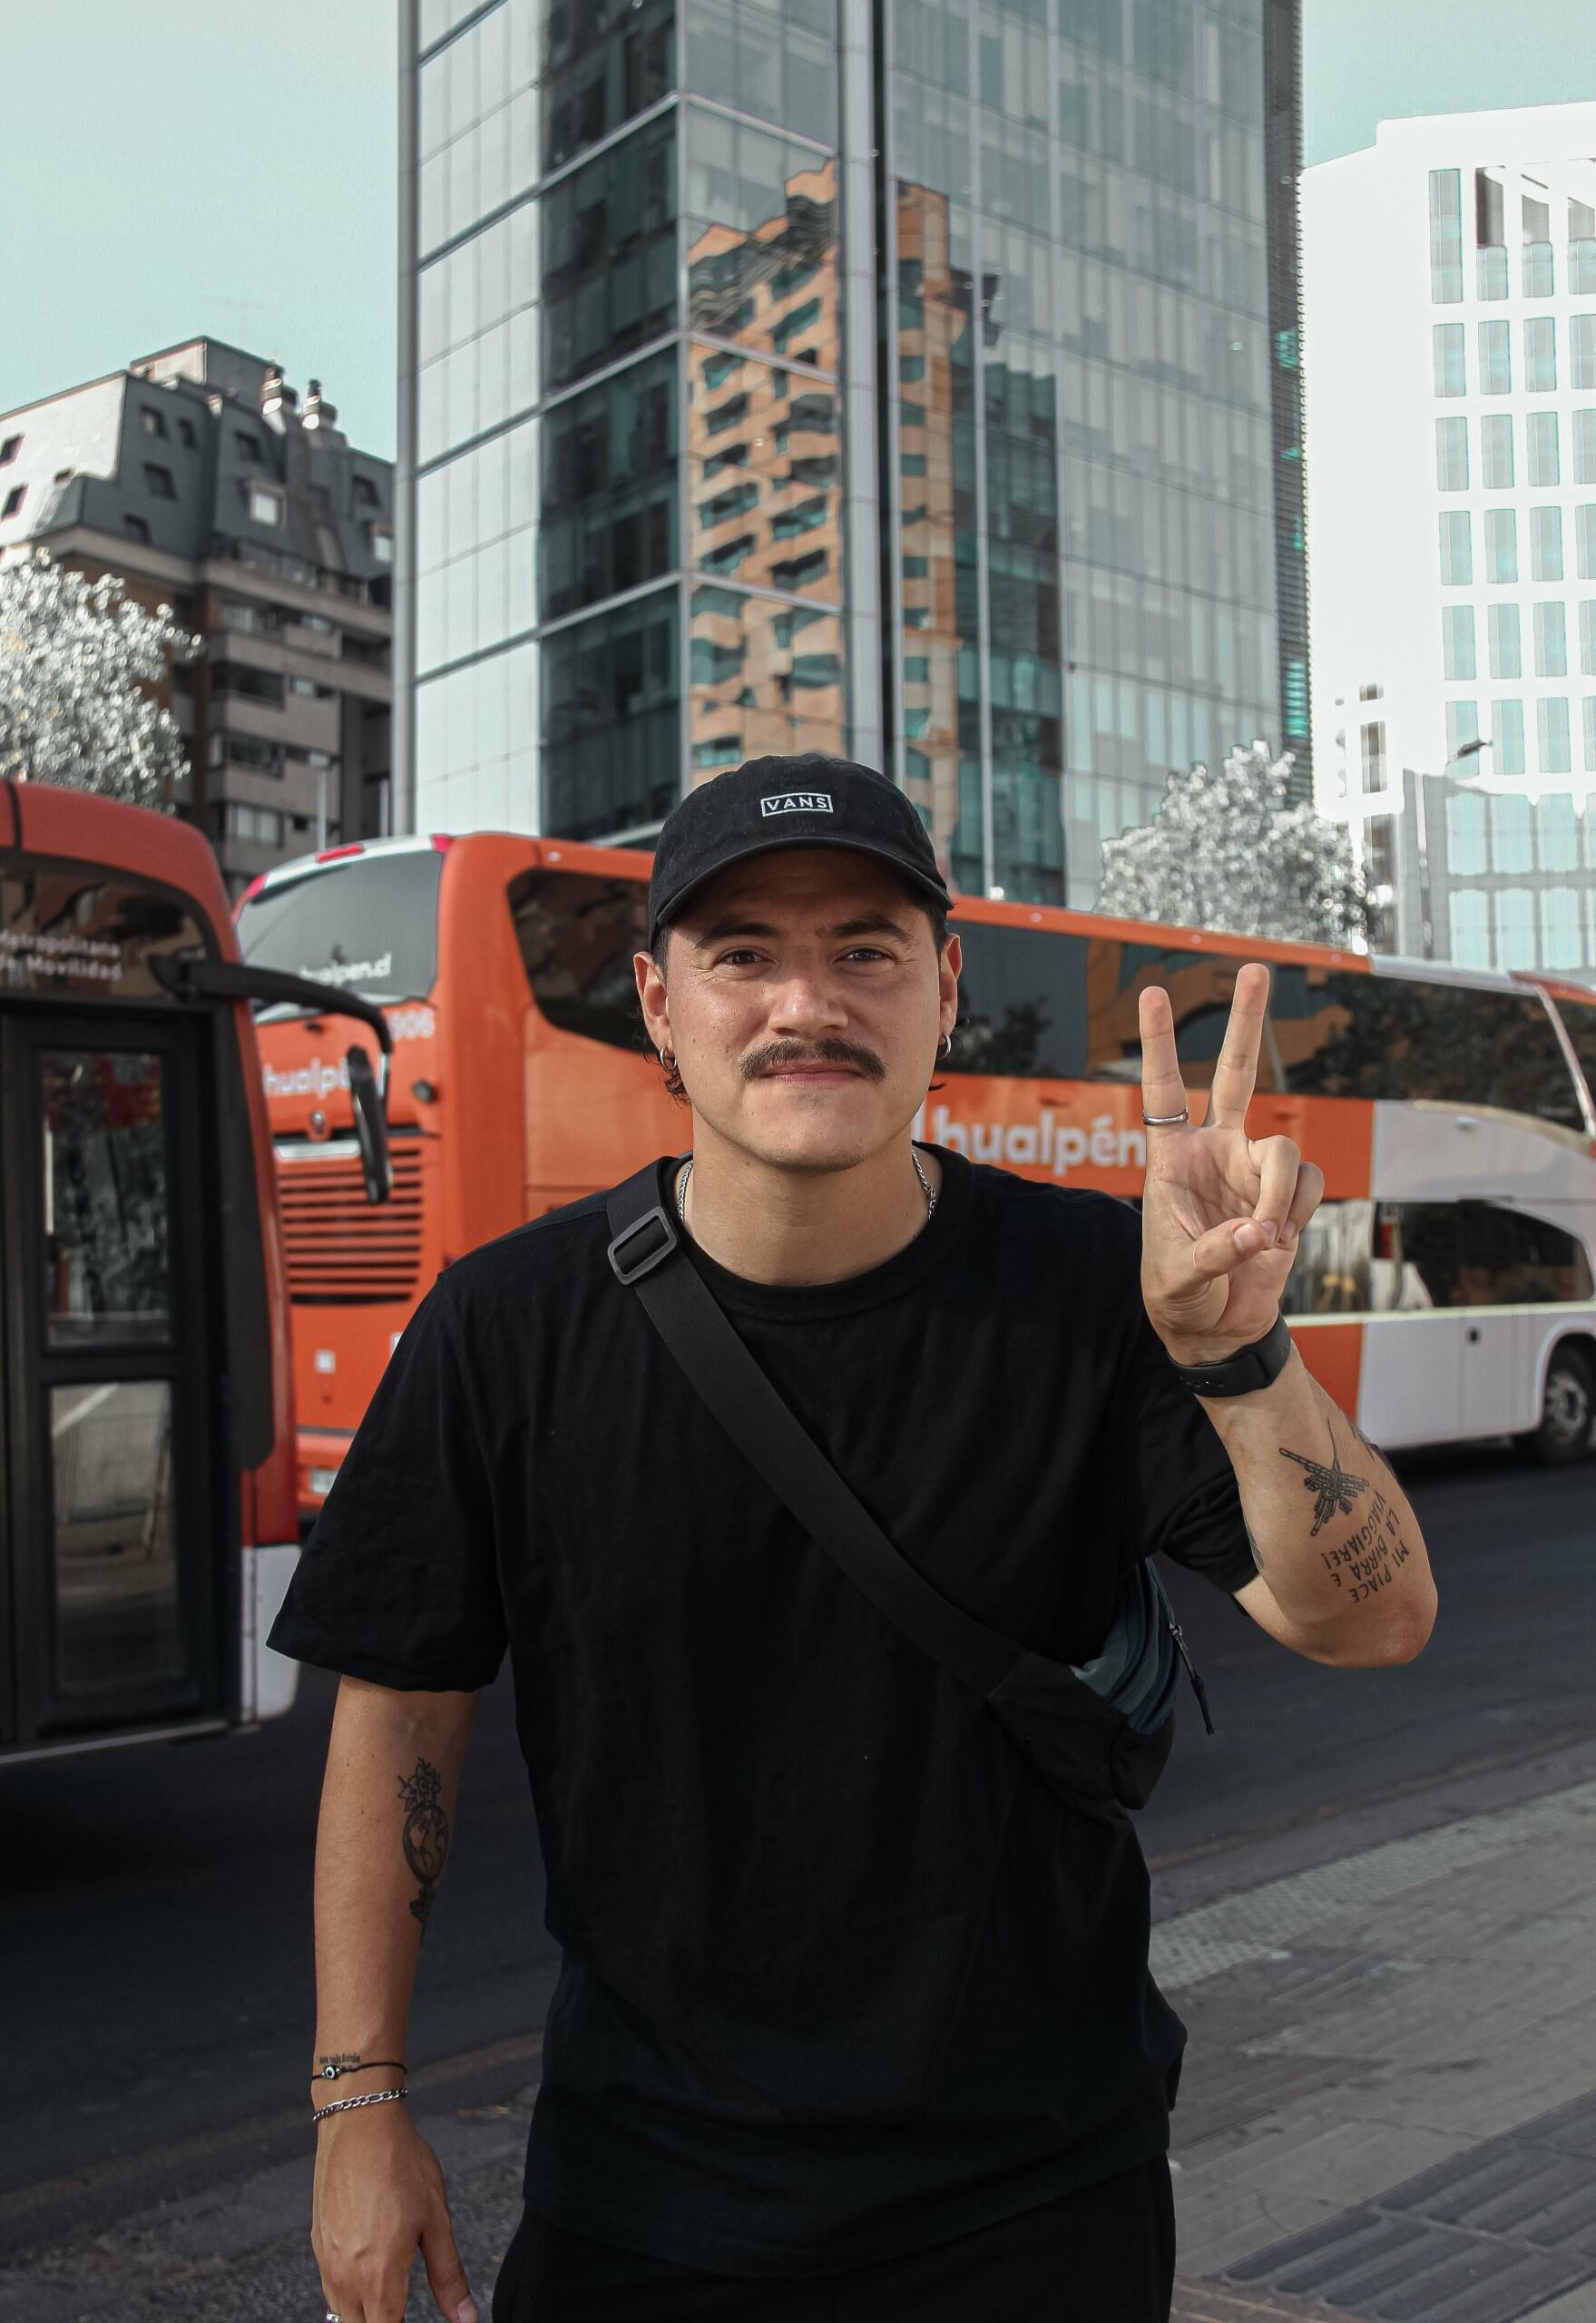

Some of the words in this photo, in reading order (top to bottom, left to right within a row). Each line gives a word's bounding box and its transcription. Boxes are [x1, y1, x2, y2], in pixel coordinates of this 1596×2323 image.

[766, 797, 827, 811] VANS
[934, 1103, 1147, 1177] hualpén
[1385, 1508, 1401, 1536] LA
[1348, 1534, 1389, 1581] BIRRA
[1391, 1539, 1409, 1568] MI
[1329, 1573, 1342, 1588] E
[1348, 1563, 1393, 1603] PIACE
